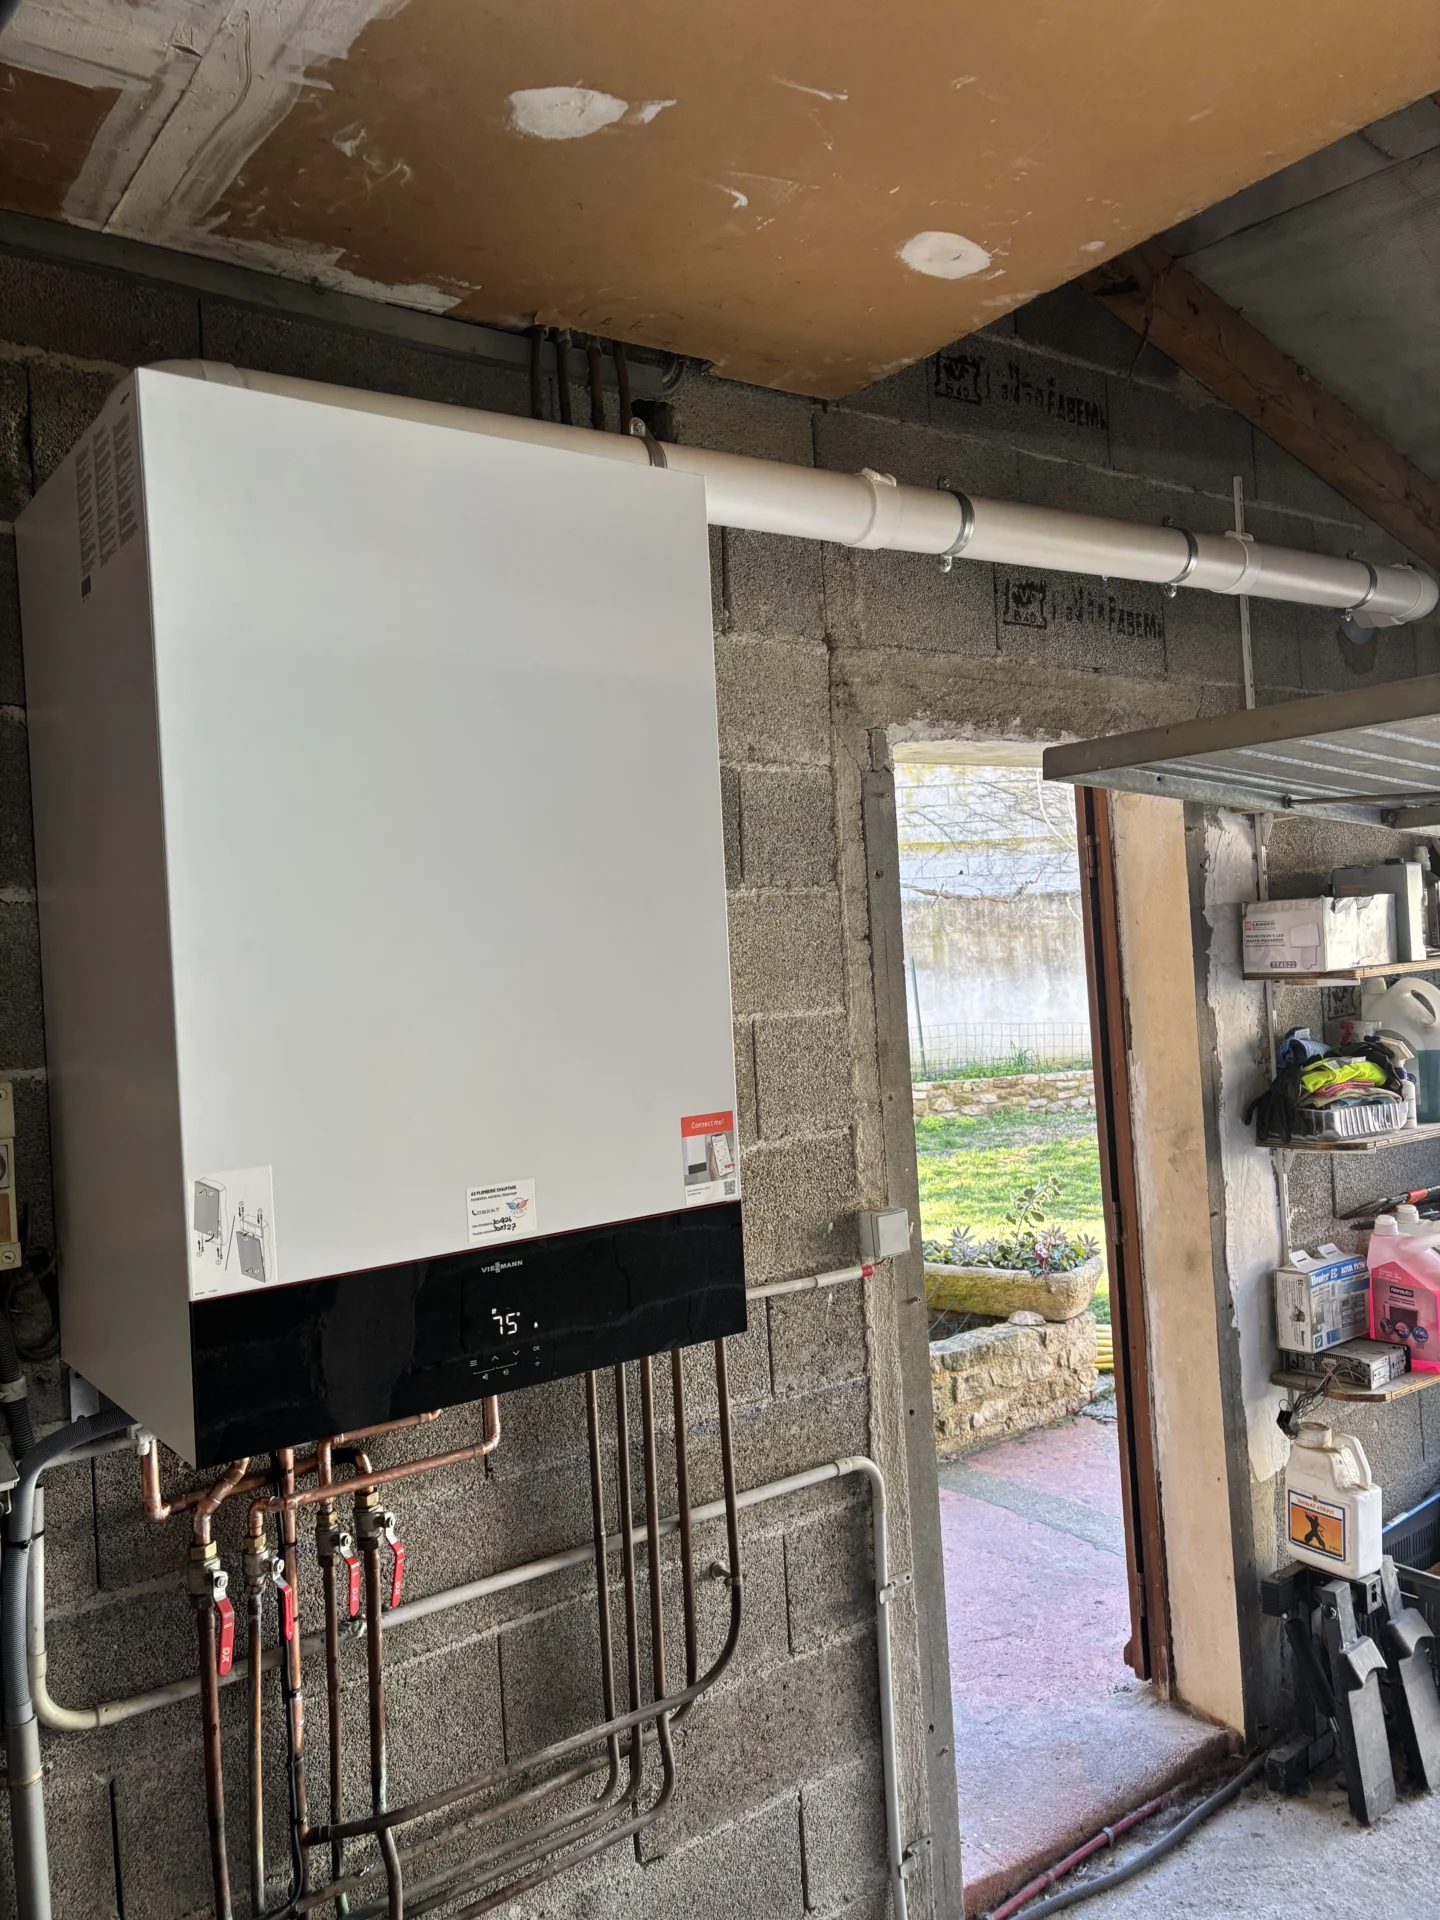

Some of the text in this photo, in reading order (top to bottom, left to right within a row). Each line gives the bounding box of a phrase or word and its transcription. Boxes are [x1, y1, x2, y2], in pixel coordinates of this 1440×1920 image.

[691, 1119, 713, 1130] Connect
[476, 1187, 496, 1195] PLOMBERIE
[481, 1260, 523, 1273] VIESSMANN
[1330, 1268, 1338, 1279] EC
[1390, 1287, 1413, 1297] Norauto
[221, 1646, 231, 1663] DX
